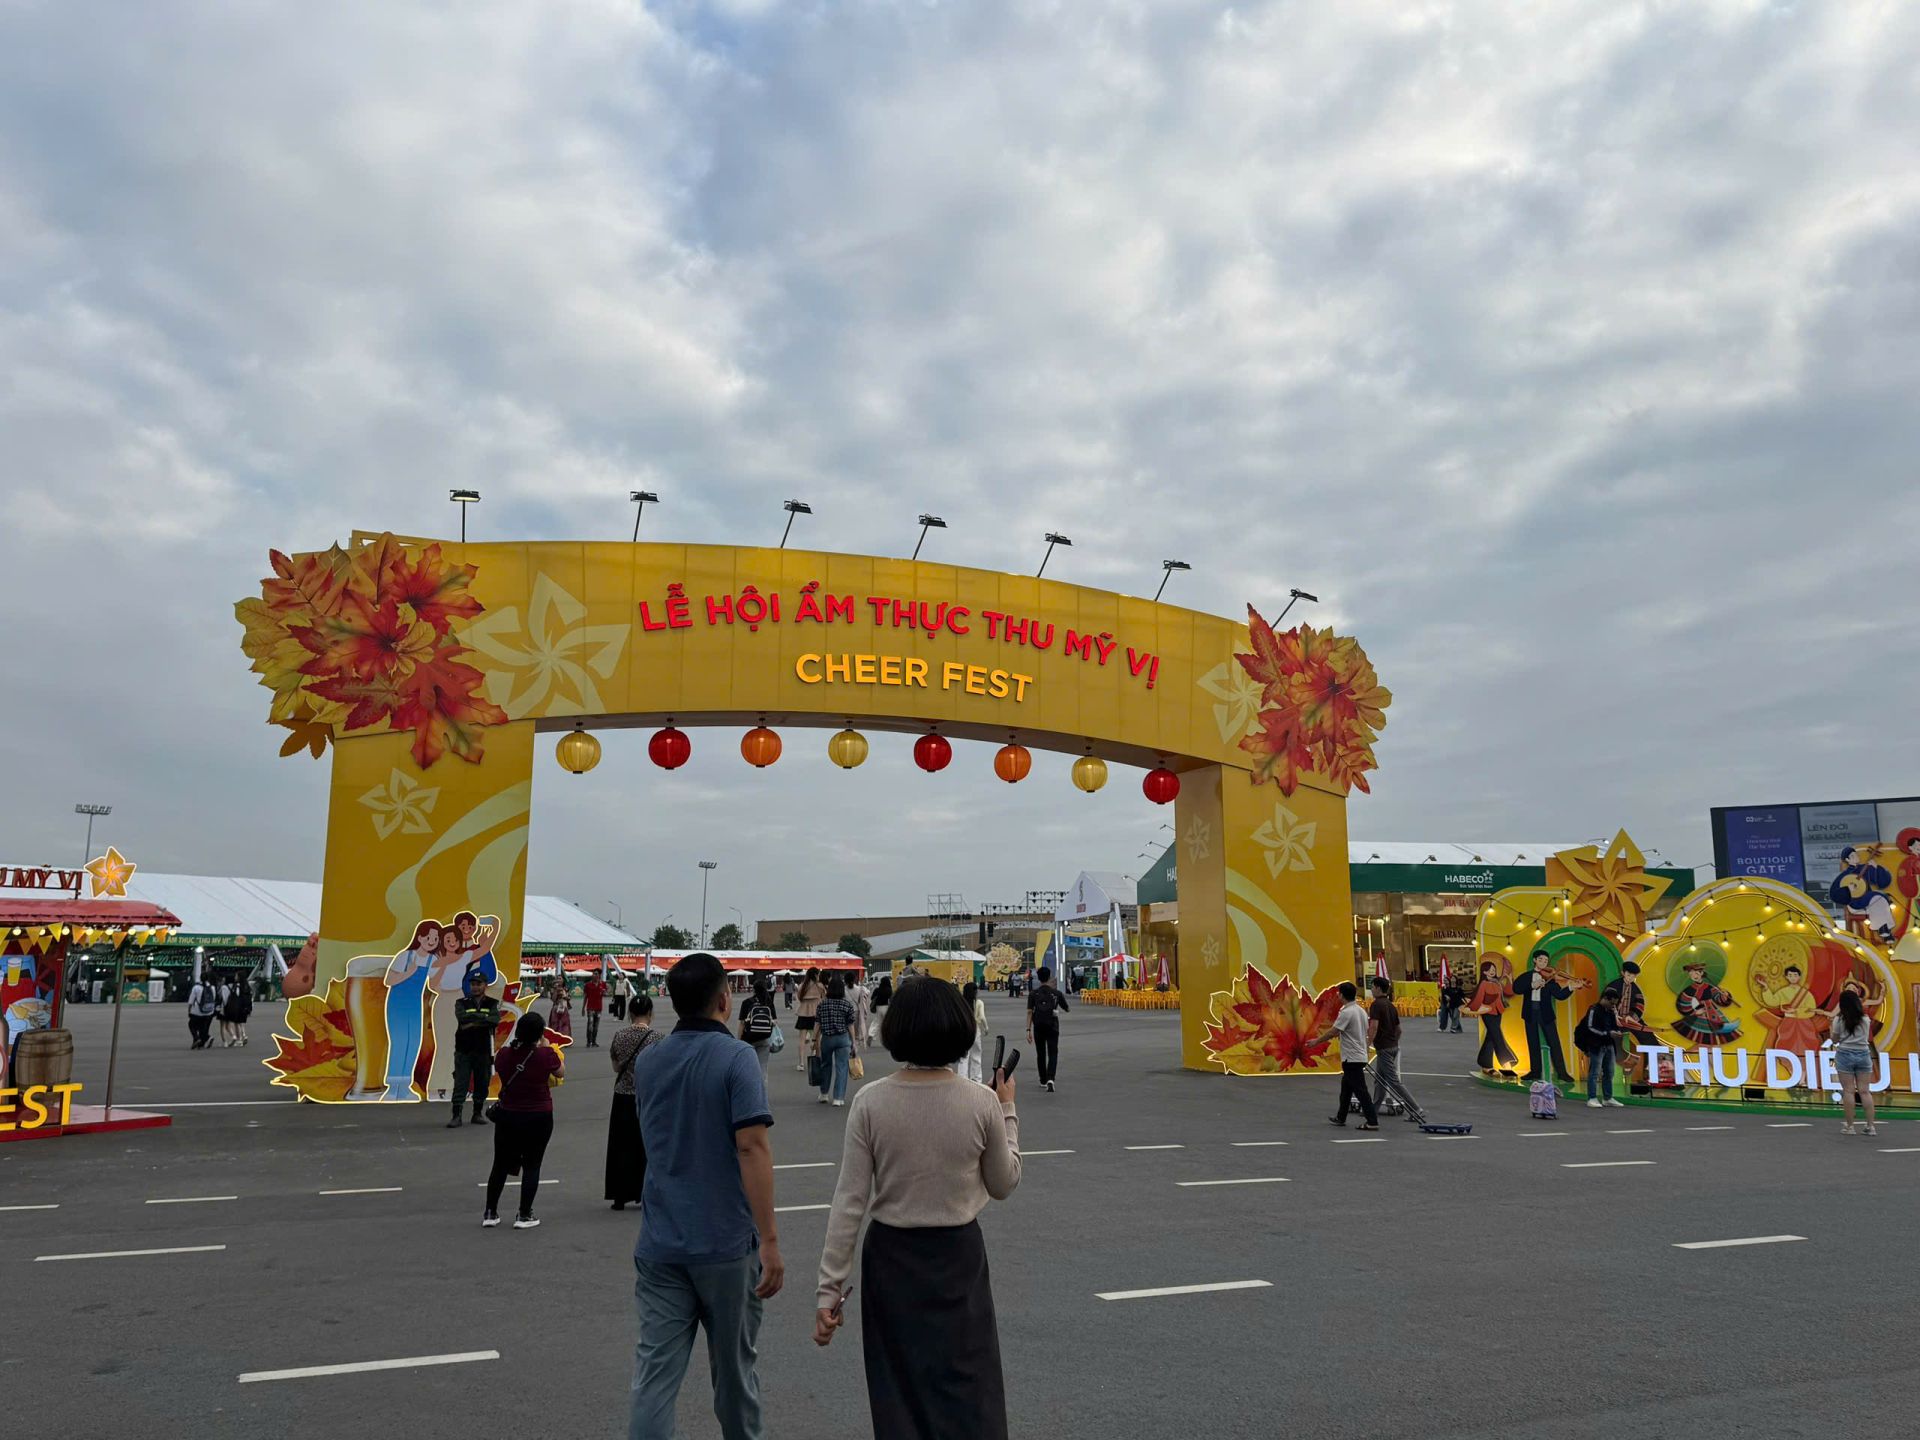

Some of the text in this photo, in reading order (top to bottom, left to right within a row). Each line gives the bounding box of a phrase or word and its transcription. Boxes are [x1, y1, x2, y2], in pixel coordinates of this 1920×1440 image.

[639, 580, 1160, 689] LỄ HỘI ẨM THỰC THU MỸ VỊ
[795, 653, 1033, 703] CHEER FEST
[1737, 856, 1796, 865] BOUTIQUE
[1166, 866, 1177, 882] HA
[1746, 864, 1786, 874] GATE
[1444, 875, 1484, 884] HABECO
[1636, 1045, 1748, 1087] THU
